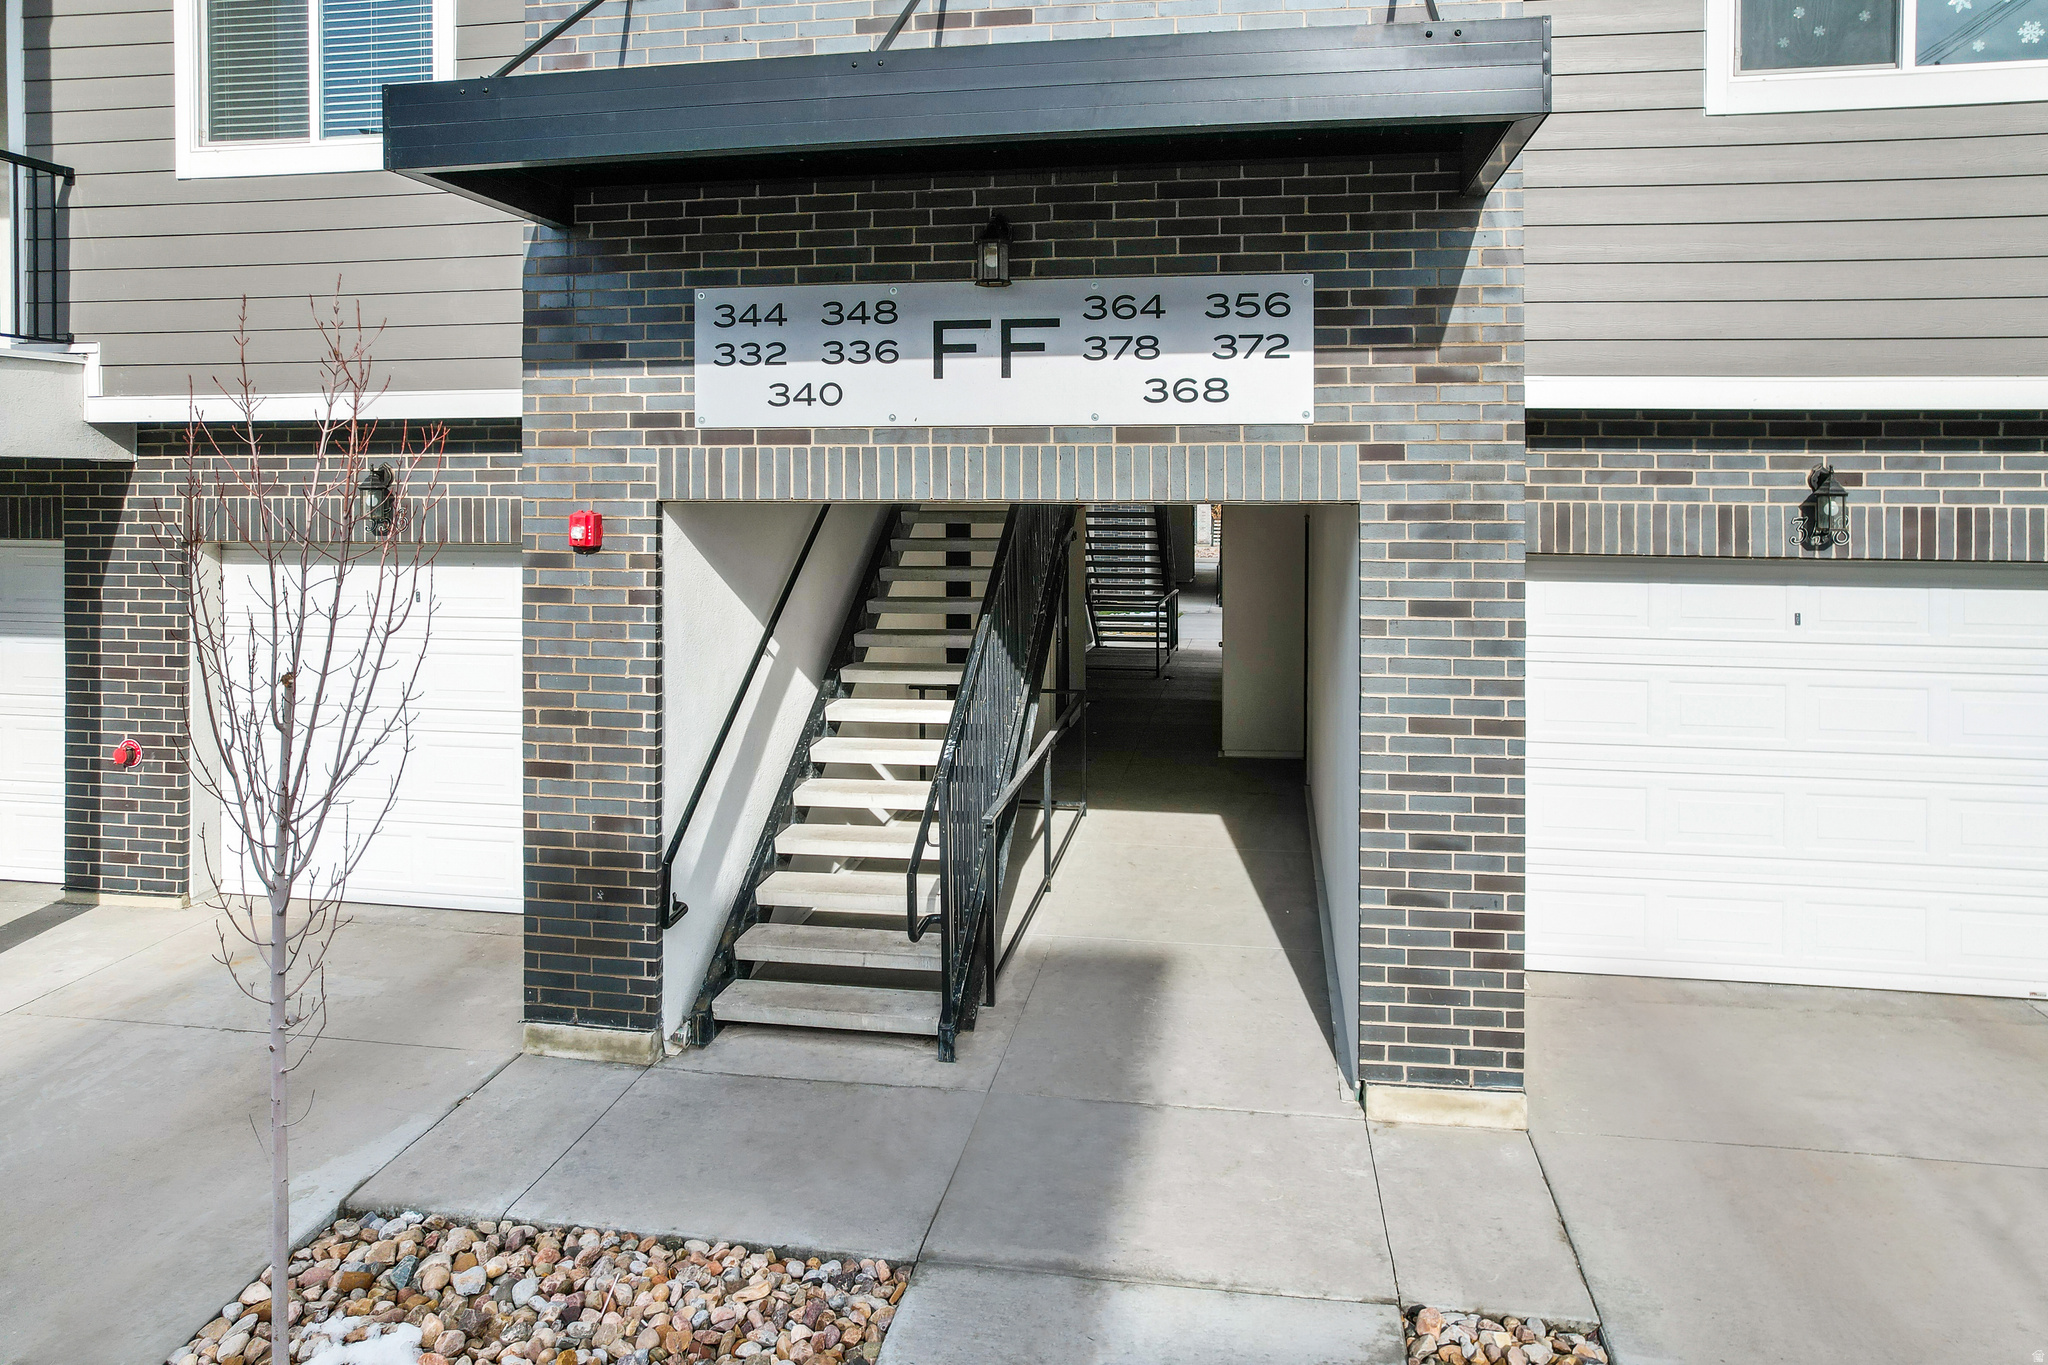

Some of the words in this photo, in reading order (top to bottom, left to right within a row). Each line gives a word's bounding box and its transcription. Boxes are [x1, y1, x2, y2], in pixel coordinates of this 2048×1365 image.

[713, 302, 788, 329] 344
[820, 299, 899, 326] 348
[1082, 293, 1167, 321] 364
[1204, 291, 1292, 319] 356
[713, 341, 787, 367] 332
[820, 339, 900, 366] 336
[932, 317, 1061, 380] FF
[1082, 334, 1161, 361] 378
[1212, 333, 1290, 360] 372
[767, 382, 843, 407] 340
[1143, 377, 1229, 404] 368
